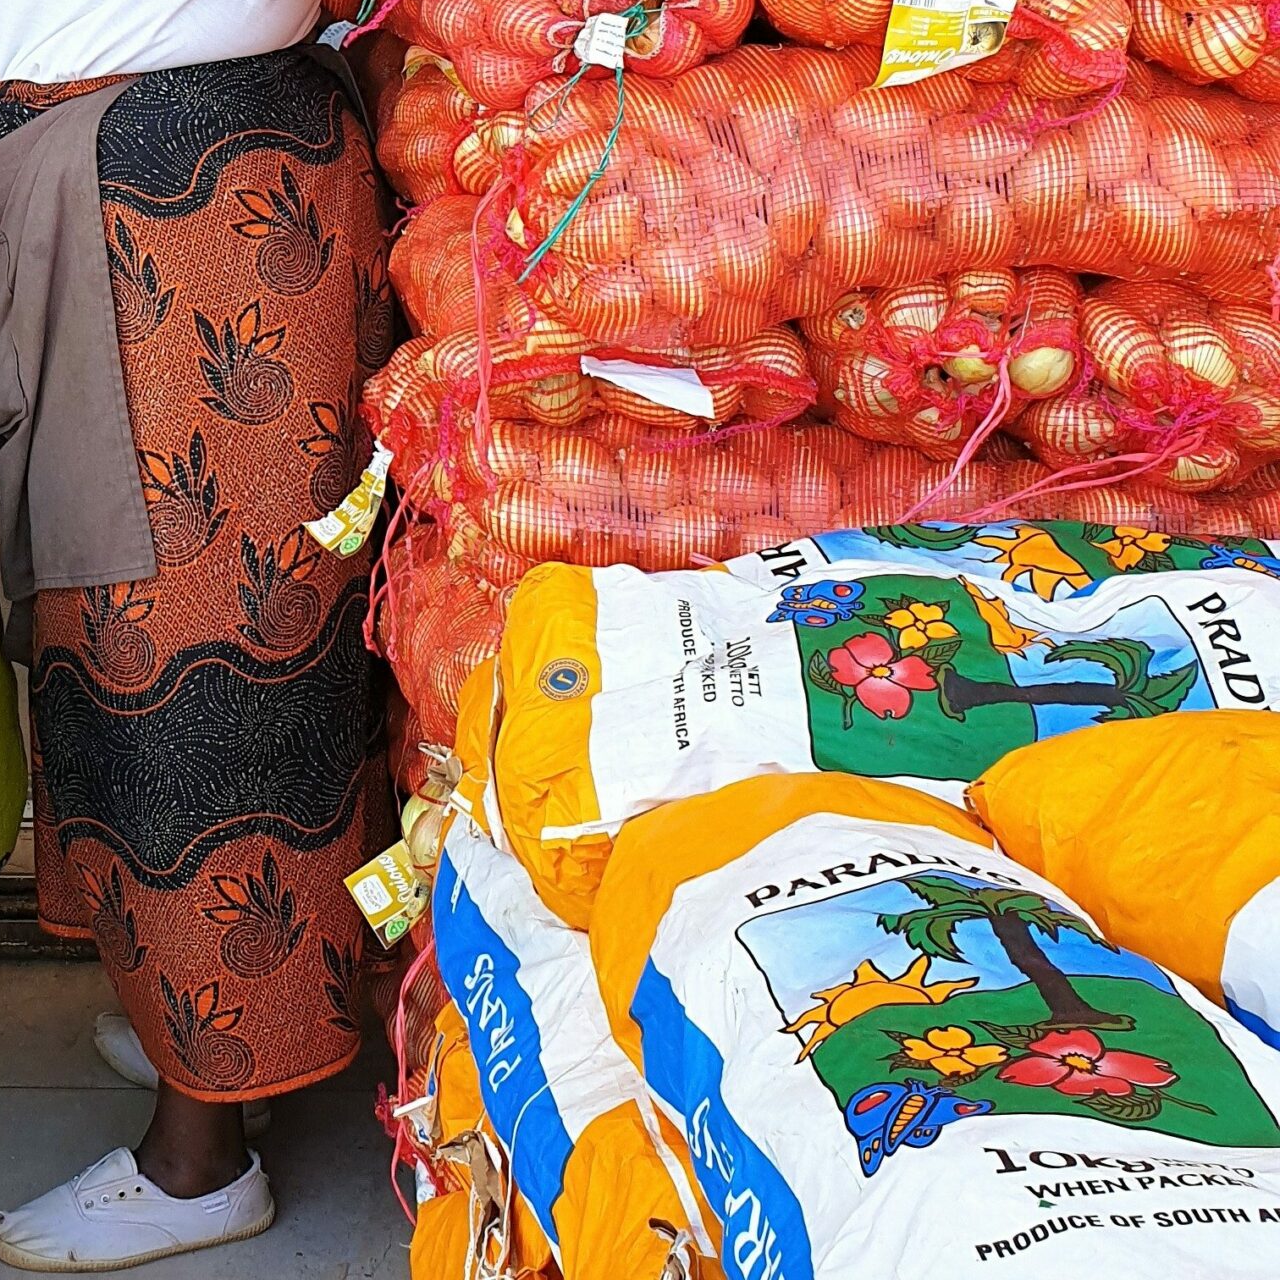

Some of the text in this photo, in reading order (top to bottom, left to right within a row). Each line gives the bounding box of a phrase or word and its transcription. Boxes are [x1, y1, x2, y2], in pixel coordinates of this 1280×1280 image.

[756, 541, 807, 577] AR
[677, 598, 696, 656] PRODUCE
[1185, 591, 1266, 706] PRAD
[673, 697, 690, 751] AFRICA
[1024, 1176, 1132, 1200] WHEN
[975, 1214, 1106, 1261] PRODUCE
[1110, 1214, 1146, 1228] OF
[1152, 1208, 1252, 1228] SOUTH
